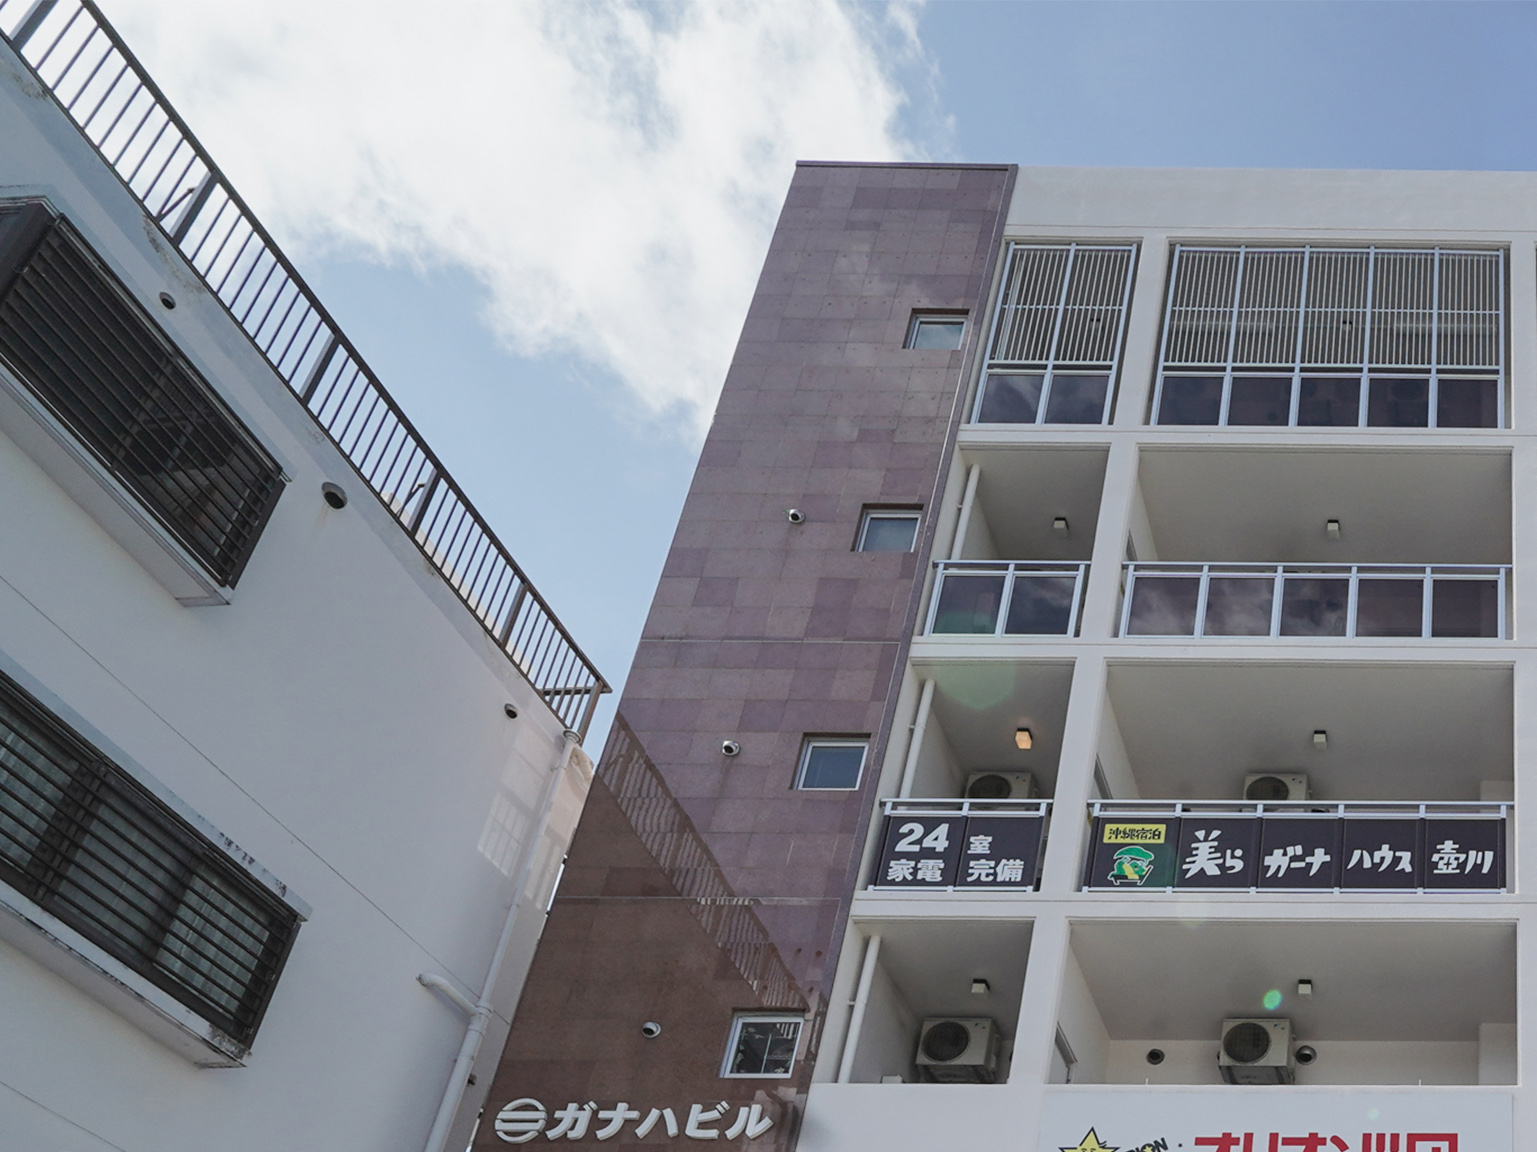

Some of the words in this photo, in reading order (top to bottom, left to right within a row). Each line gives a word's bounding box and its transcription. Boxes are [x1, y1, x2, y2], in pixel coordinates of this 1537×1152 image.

[545, 1100, 774, 1141] ガナハビル
